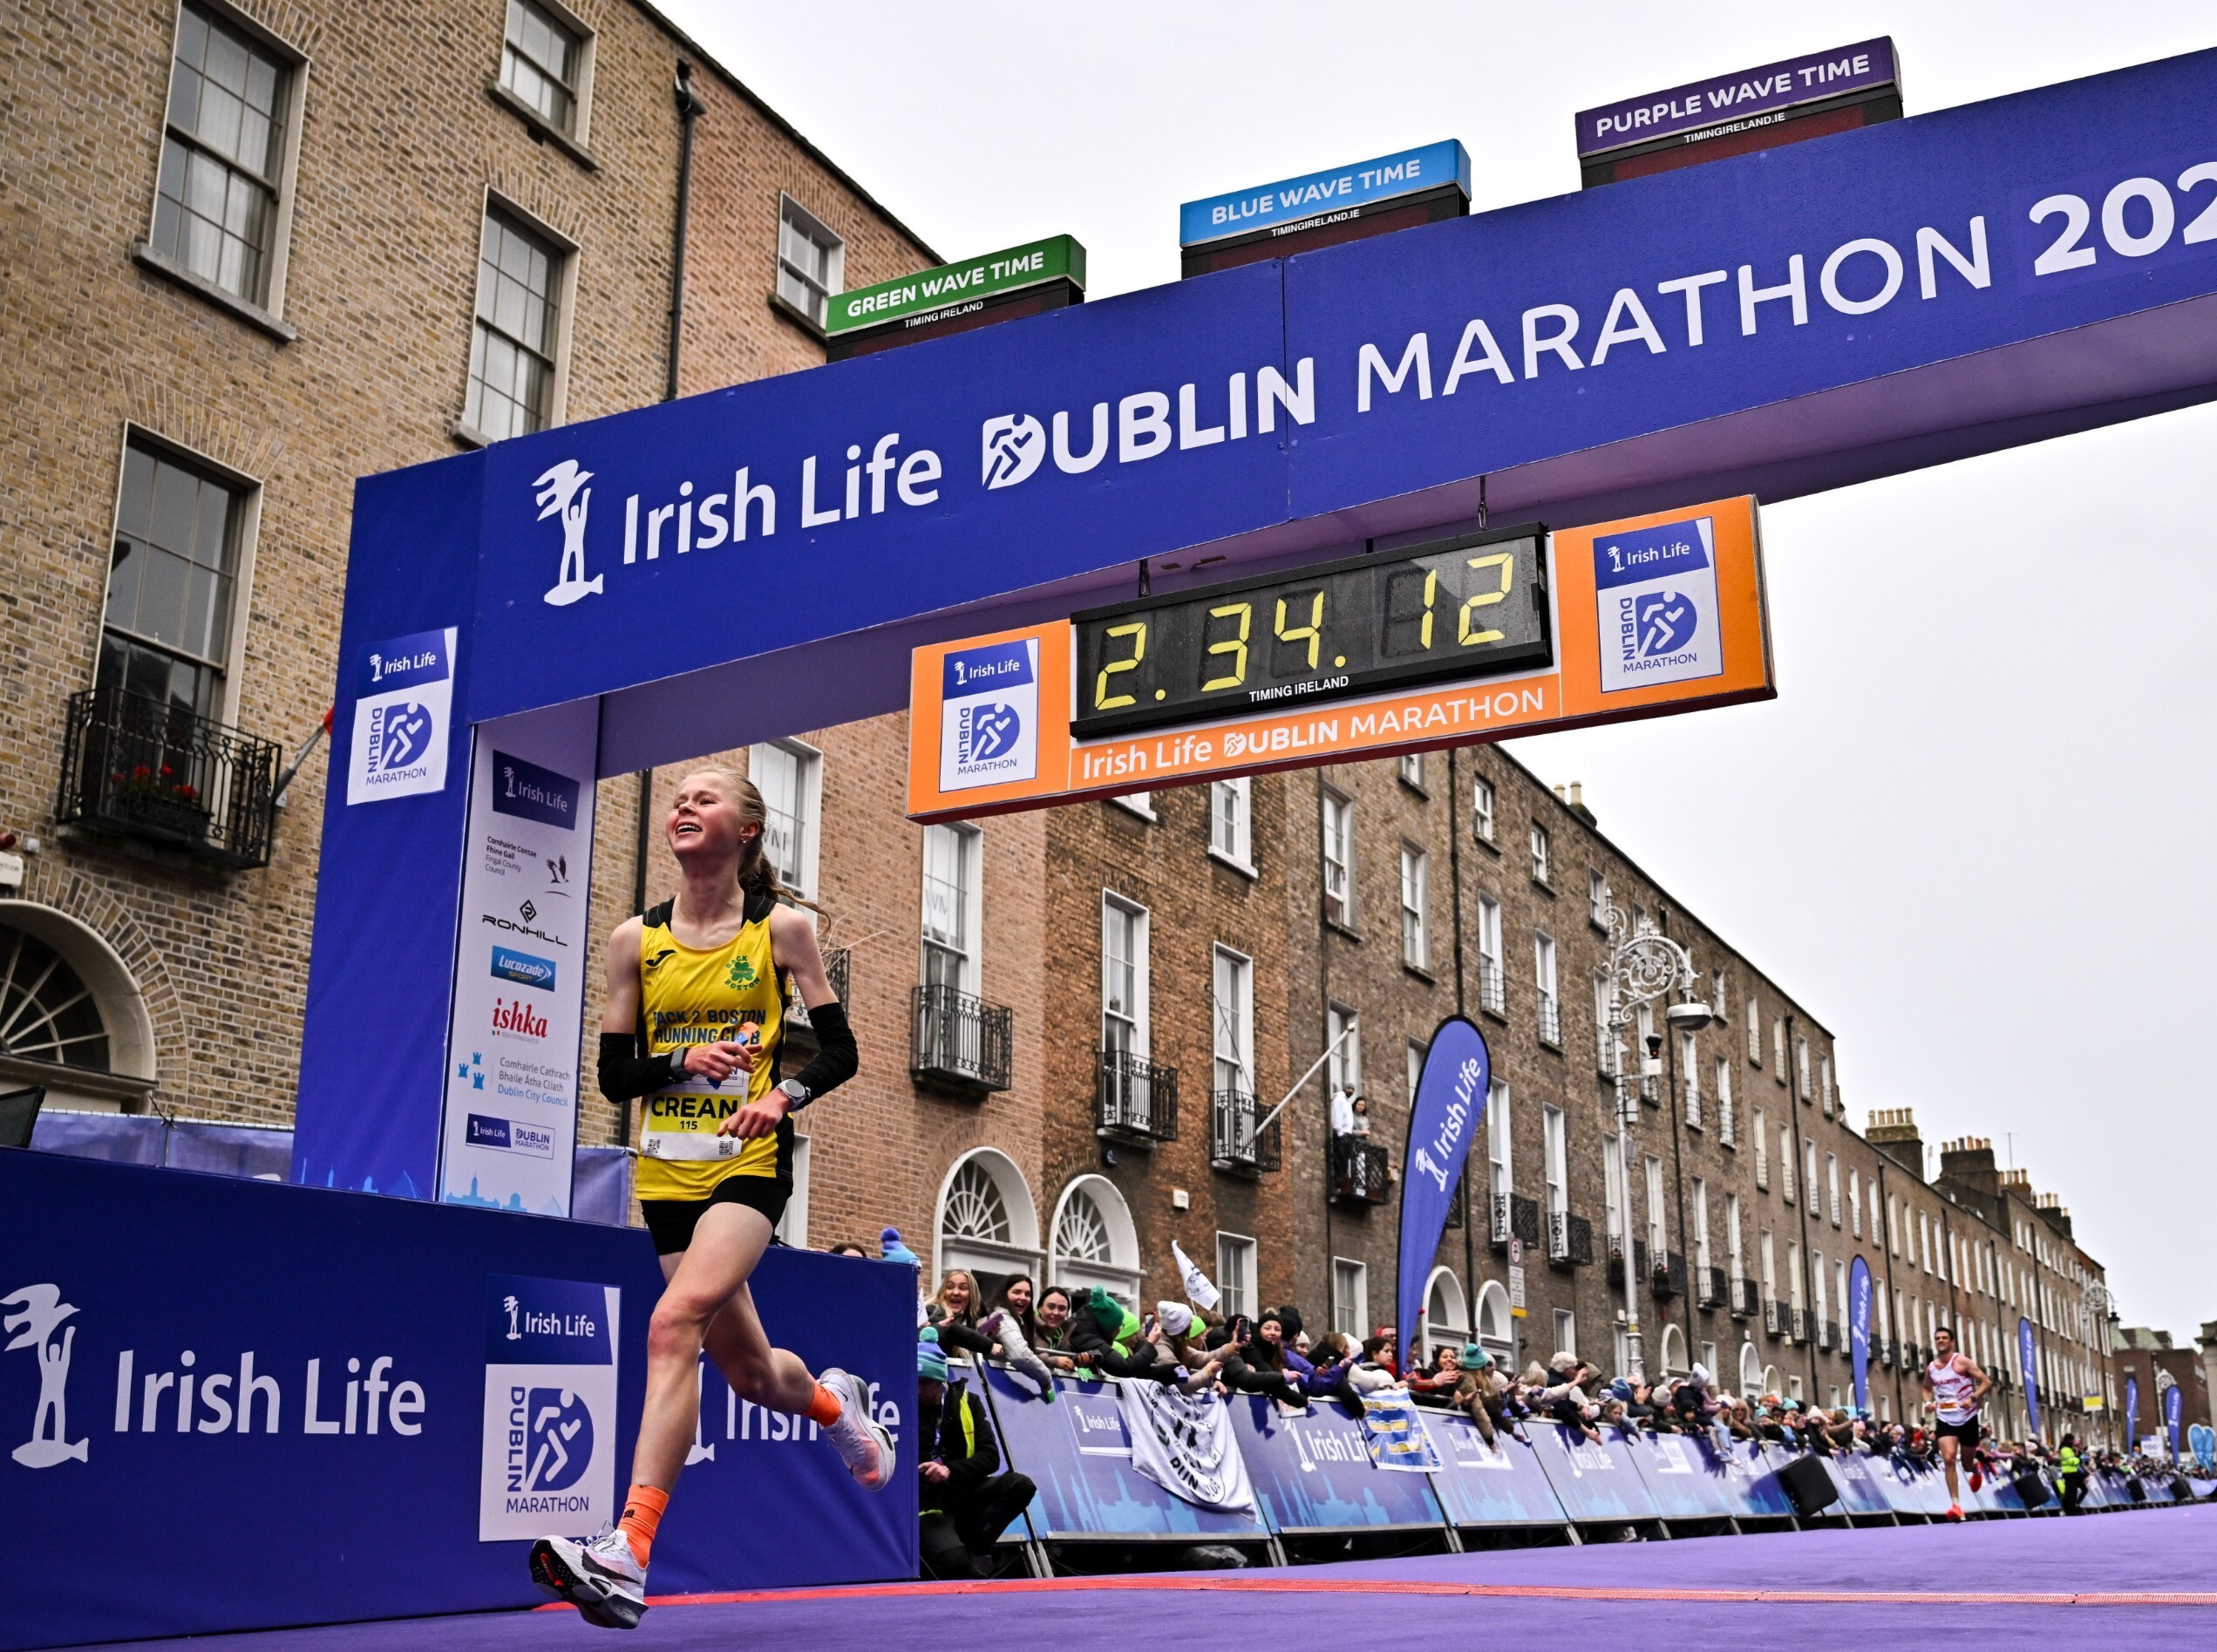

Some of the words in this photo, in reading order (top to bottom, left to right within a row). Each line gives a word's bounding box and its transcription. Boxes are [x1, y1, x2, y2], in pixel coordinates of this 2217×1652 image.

[1596, 94, 1702, 137] PURPLE
[1708, 72, 1792, 108] WAVE
[1798, 54, 1870, 86] TIME
[1684, 112, 1785, 144] TIMINGIRELAND.IE
[1212, 194, 1274, 225] BLUE
[1280, 176, 1352, 207] WAVE
[1359, 159, 1420, 189] TIME
[1271, 209, 1360, 237] TIMINGIRELAND.IE
[847, 285, 916, 317] GREEN
[921, 268, 984, 297] WAVE
[990, 252, 1044, 280] TIME
[905, 312, 939, 328] TIMING
[940, 301, 983, 320] IRELAND
[623, 466, 776, 565] Irish
[801, 433, 942, 528] Life
[1357, 215, 1991, 412] MARATHON
[1626, 547, 1660, 565] Irish
[1663, 542, 1690, 559] Life
[1421, 552, 1513, 650] 12
[1619, 597, 1636, 660] DUBLIN
[384, 656, 411, 675] Irish
[413, 651, 437, 669] Life
[969, 660, 995, 679] Irish
[996, 658, 1020, 675] Life
[1622, 653, 1697, 673] MARATHON
[1248, 684, 1293, 704] TIMING
[1294, 676, 1350, 696] IRELAND
[367, 707, 383, 773] DUBLIN
[958, 707, 970, 765] DUBLIN
[1083, 744, 1149, 779] Irish
[1155, 734, 1213, 769] Life
[1350, 687, 1543, 739] MARATHON
[365, 767, 426, 785] MARATHON
[957, 758, 1017, 776] MARATHON
[519, 782, 544, 804] Irish
[547, 793, 568, 812] Life
[486, 845, 502, 855] Fhine
[504, 851, 514, 860] Gall
[487, 836, 516, 851] Comhairle
[517, 846, 537, 858] Contae
[486, 854, 501, 865] Fingal
[503, 860, 521, 873] County
[486, 864, 505, 875] Council
[482, 914, 568, 947] RONHILL
[499, 955, 544, 976] Lucozade
[493, 997, 547, 1038] ishka
[692, 1010, 701, 1023] 2
[707, 1010, 766, 1025] BOSTON
[720, 1027, 761, 1045] CLB
[500, 1057, 539, 1073] Comhairle
[540, 1065, 570, 1080] Cathrach
[499, 1071, 523, 1084] Bhaile
[524, 1074, 541, 1088] Átha
[543, 1080, 563, 1092] Cliath
[498, 1084, 523, 1098] Dublin
[525, 1090, 541, 1104] City
[541, 1093, 568, 1106] Council
[651, 1096, 738, 1119] CREAN
[1433, 1103, 1467, 1160] Irish
[1454, 1057, 1481, 1106] Life
[479, 1126, 493, 1137] Irish
[493, 1129, 506, 1139] Life
[680, 1120, 698, 1130] 115
[515, 1139, 549, 1151] MARATHON
[525, 1311, 562, 1336] Irish
[565, 1315, 596, 1338] Life
[114, 1349, 281, 1434] Irish
[303, 1356, 426, 1437] Life
[1086, 1415, 1106, 1430] Irish
[1105, 1417, 1121, 1431] Life
[507, 1386, 527, 1493] DUBLIN
[1306, 1430, 1350, 1461] Irish
[1343, 1431, 1370, 1462] Lif
[506, 1496, 590, 1514] MARATHON
